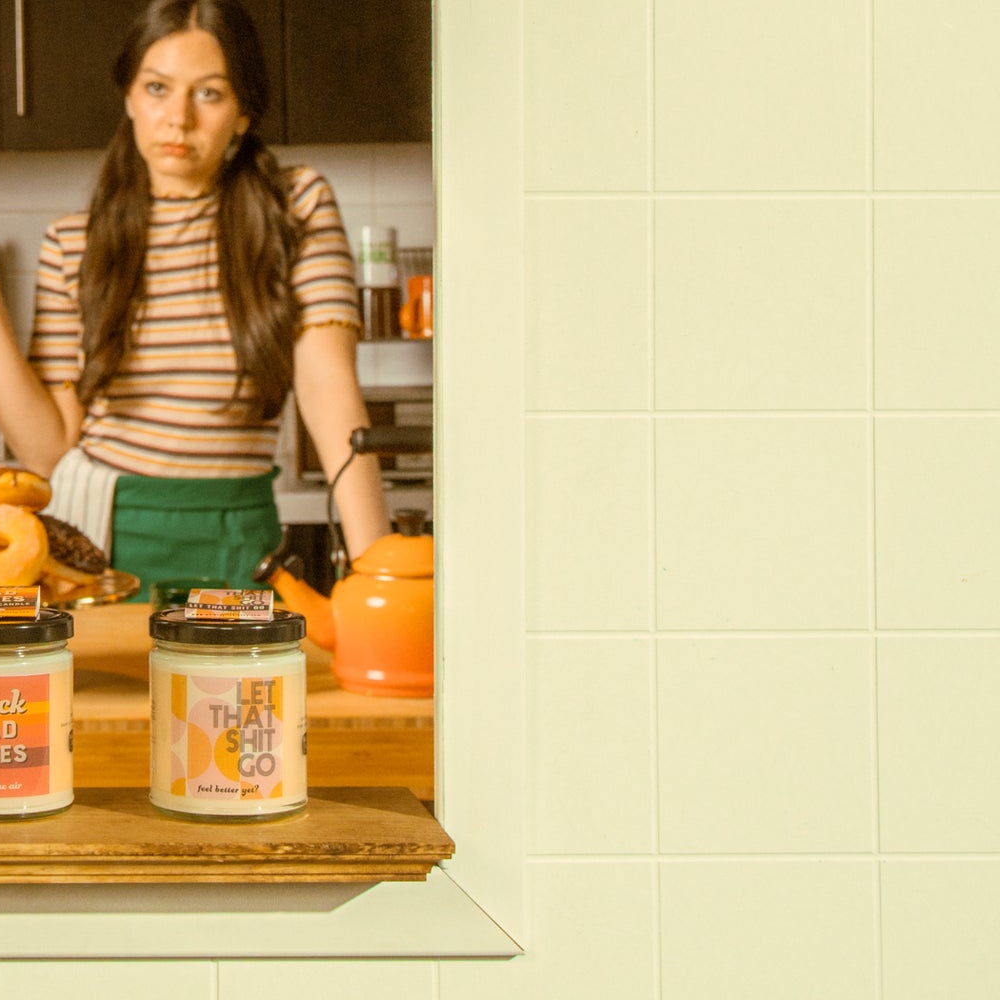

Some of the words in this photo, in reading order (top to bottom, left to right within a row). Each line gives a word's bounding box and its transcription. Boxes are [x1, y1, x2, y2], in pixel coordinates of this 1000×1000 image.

[236, 680, 276, 706] LET
[209, 704, 276, 729] THAT
[226, 728, 276, 754] SHIT
[237, 752, 276, 778] GO
[8, 781, 22, 790] air
[197, 784, 213, 793] feel
[214, 785, 240, 794] better
[241, 784, 260, 797] yet?
